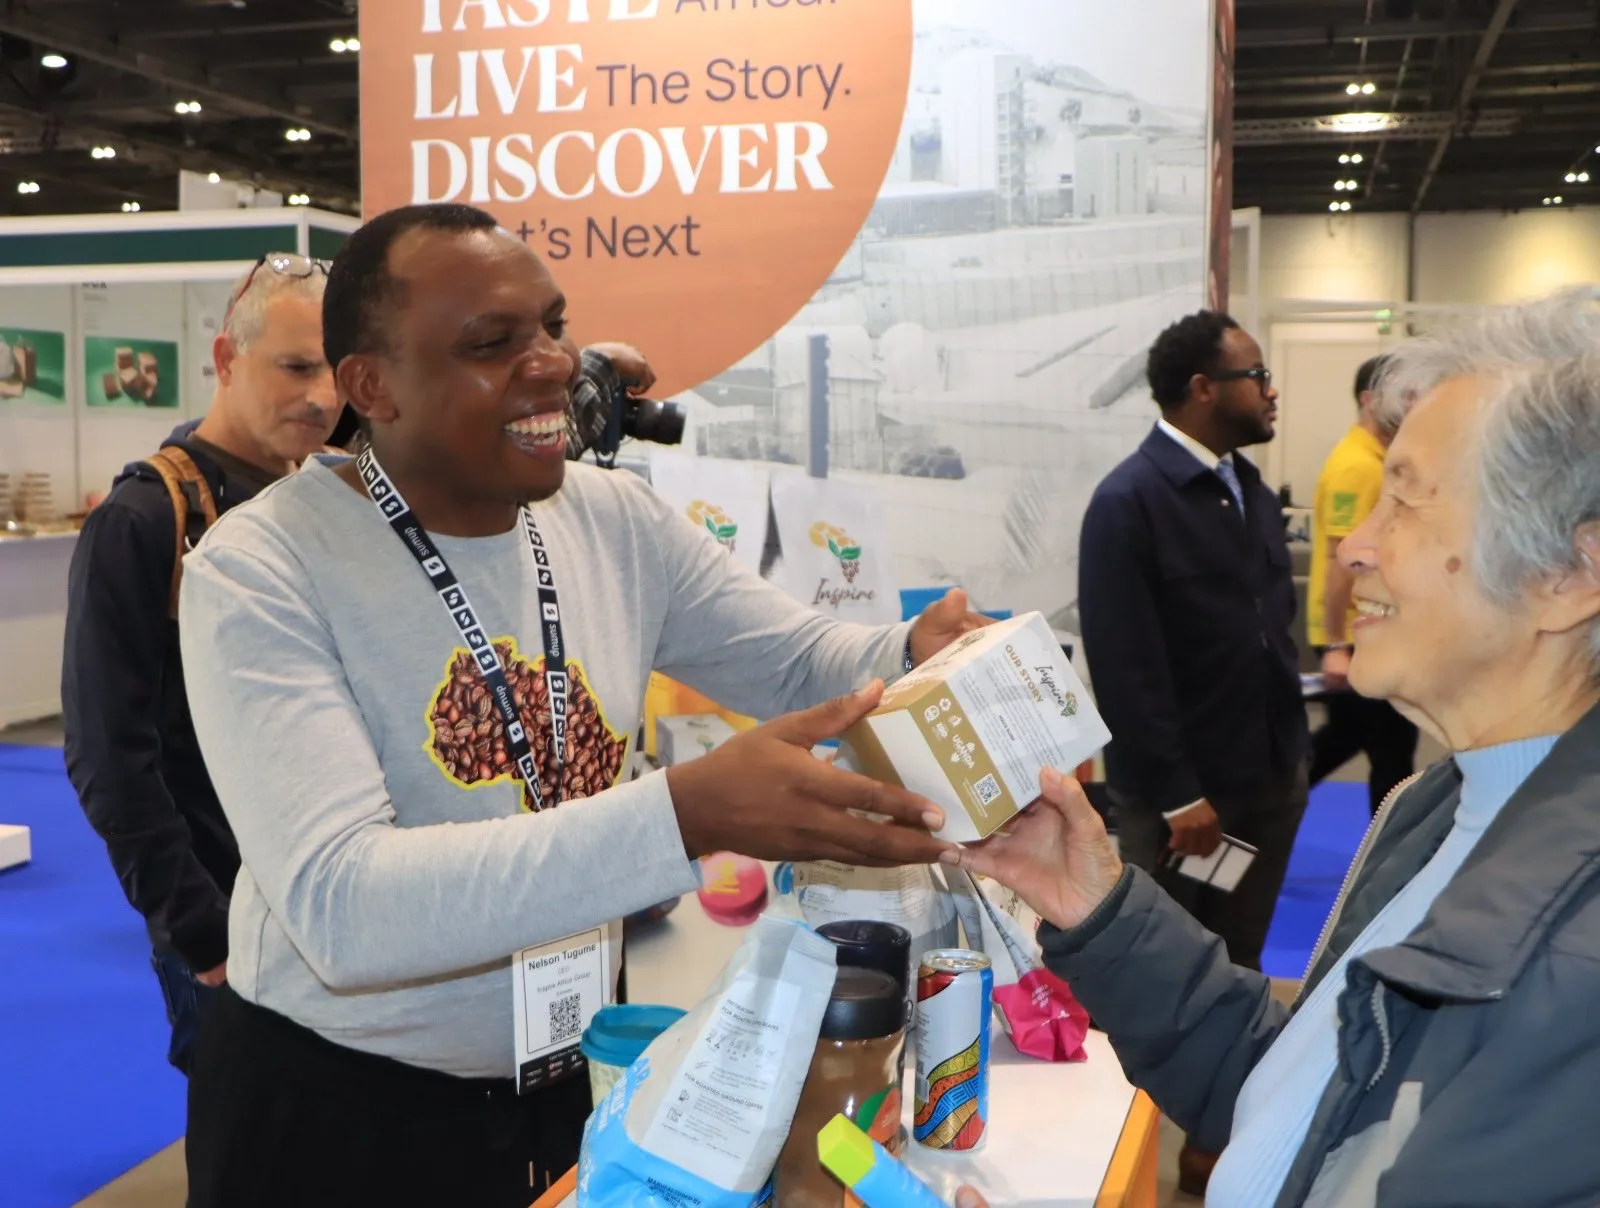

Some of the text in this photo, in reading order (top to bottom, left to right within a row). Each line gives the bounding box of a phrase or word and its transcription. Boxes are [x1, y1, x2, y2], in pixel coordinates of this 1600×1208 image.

[413, 43, 850, 120] LIVE The Story.
[411, 122, 835, 205] DISCOVER
[586, 215, 700, 258] Next
[812, 577, 876, 608] Inspire
[1005, 644, 1023, 670] OUR
[1019, 667, 1045, 704] STORY
[1034, 664, 1066, 707] Inspire
[952, 734, 976, 769] UGANDA
[528, 944, 596, 971] Nelson Tugume
